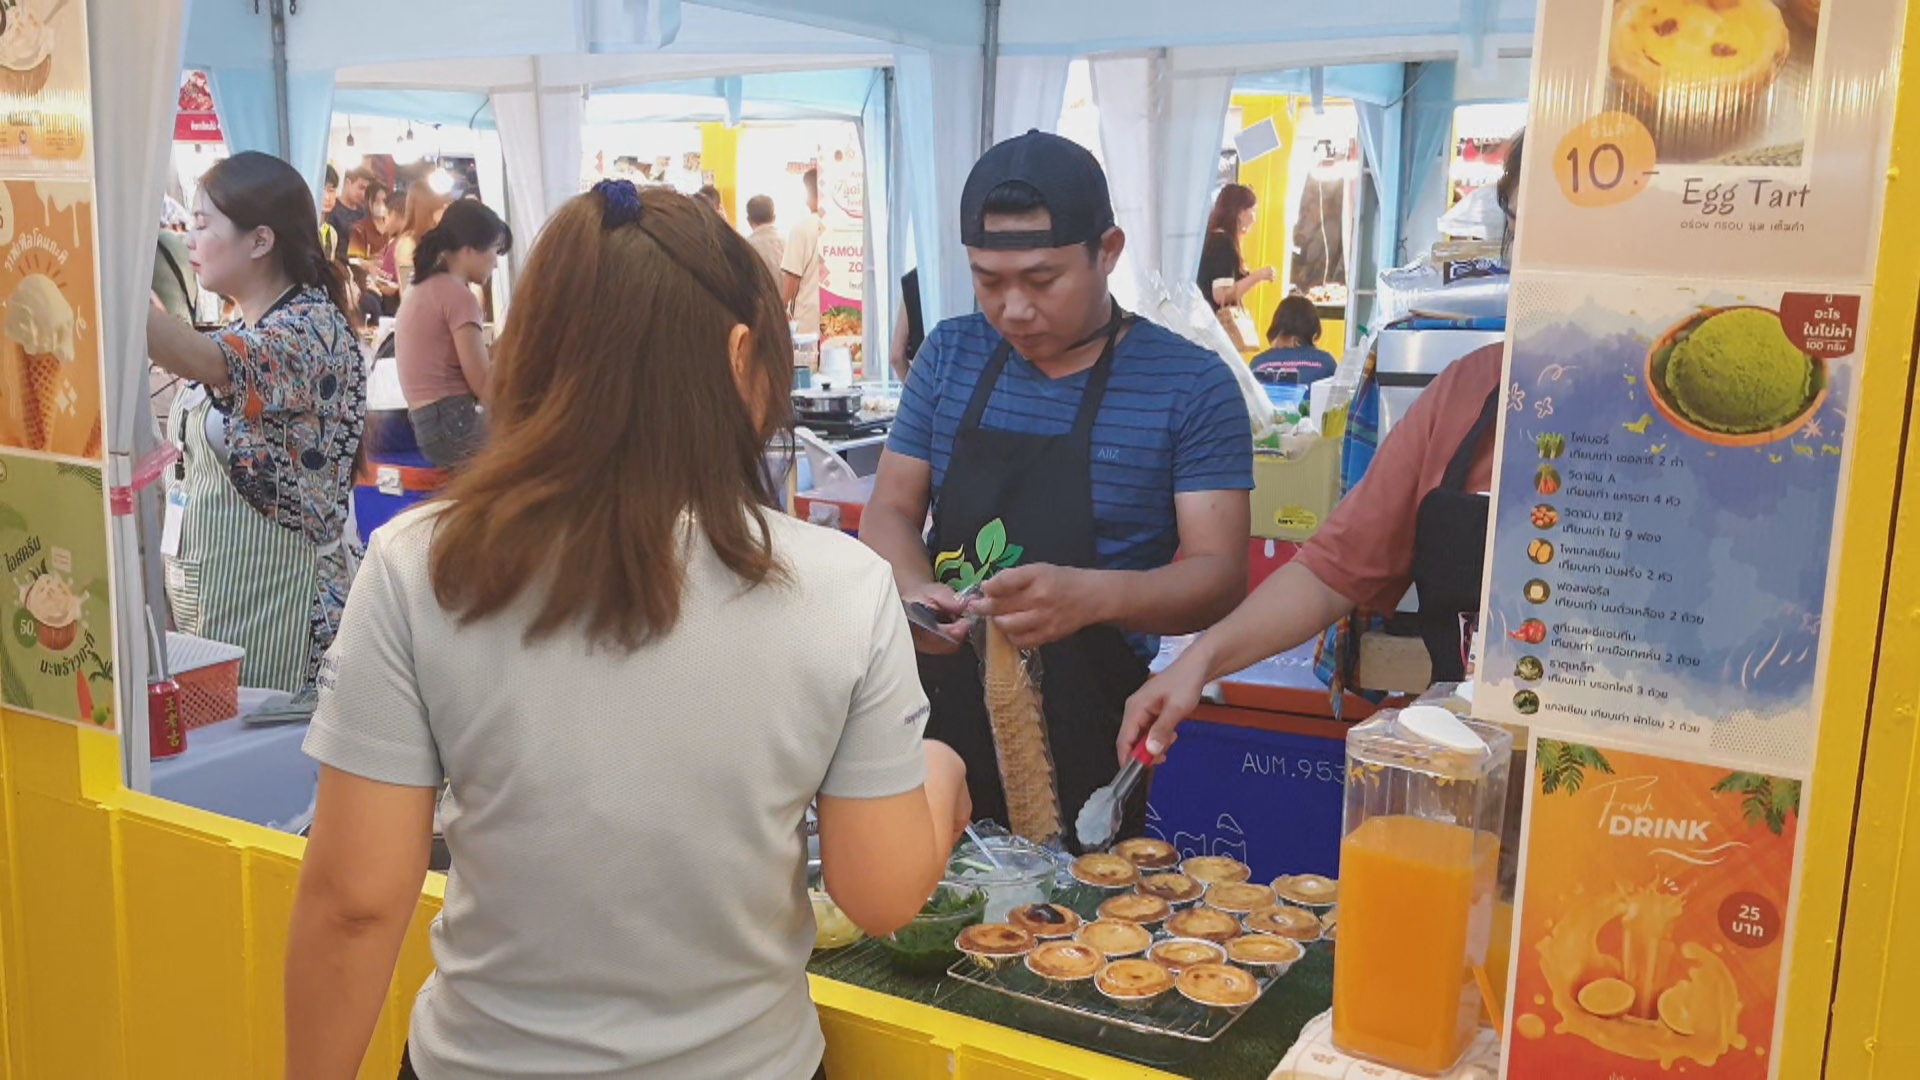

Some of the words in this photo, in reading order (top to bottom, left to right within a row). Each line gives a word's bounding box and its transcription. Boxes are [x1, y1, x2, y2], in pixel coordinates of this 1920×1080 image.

[1682, 177, 1739, 215] Egg
[1748, 179, 1811, 208] Tart
[1714, 220, 1743, 230] กรอบ
[1814, 307, 1840, 320] อะไร
[1806, 341, 1823, 351] 100
[1826, 341, 1846, 351] กรัม
[1569, 448, 1612, 461] เทียบเท่า
[1659, 456, 1666, 467] 2
[1568, 469, 1603, 483] วิตามิน
[1607, 473, 1616, 483] A
[1566, 486, 1609, 499] เทียบเท่า
[1653, 494, 1661, 504] 4
[1665, 495, 1681, 507] หัว
[1564, 507, 1599, 521] วิตามิน
[1603, 511, 1623, 522] B12
[1562, 524, 1605, 537] เทียบเท่า
[1609, 526, 1620, 539] ไข่
[1624, 529, 1633, 541] 9
[1637, 531, 1662, 543] ฟอง
[1558, 560, 1601, 574] เทียบเท่า
[1647, 570, 1654, 581] 2
[1658, 571, 1673, 583] หัว
[1555, 598, 1597, 611] เทียบเท่า
[1669, 611, 1677, 621] 2
[1681, 611, 1704, 625] ถ้วย
[1551, 638, 1593, 653] เทียบเท่า
[1665, 653, 1673, 663] 2
[1677, 653, 1700, 667] ถ้วย
[1548, 674, 1586, 687] เทียบเท่า
[1636, 685, 1644, 695] 3
[1647, 686, 1668, 699] ถ้วย
[1590, 708, 1630, 722] เทียบเท่า
[1669, 720, 1676, 729] 2
[1679, 722, 1700, 734] ถ้วย
[1608, 815, 1712, 842] DRINK
[1738, 904, 1760, 921] 25
[1732, 921, 1764, 937] บาท
